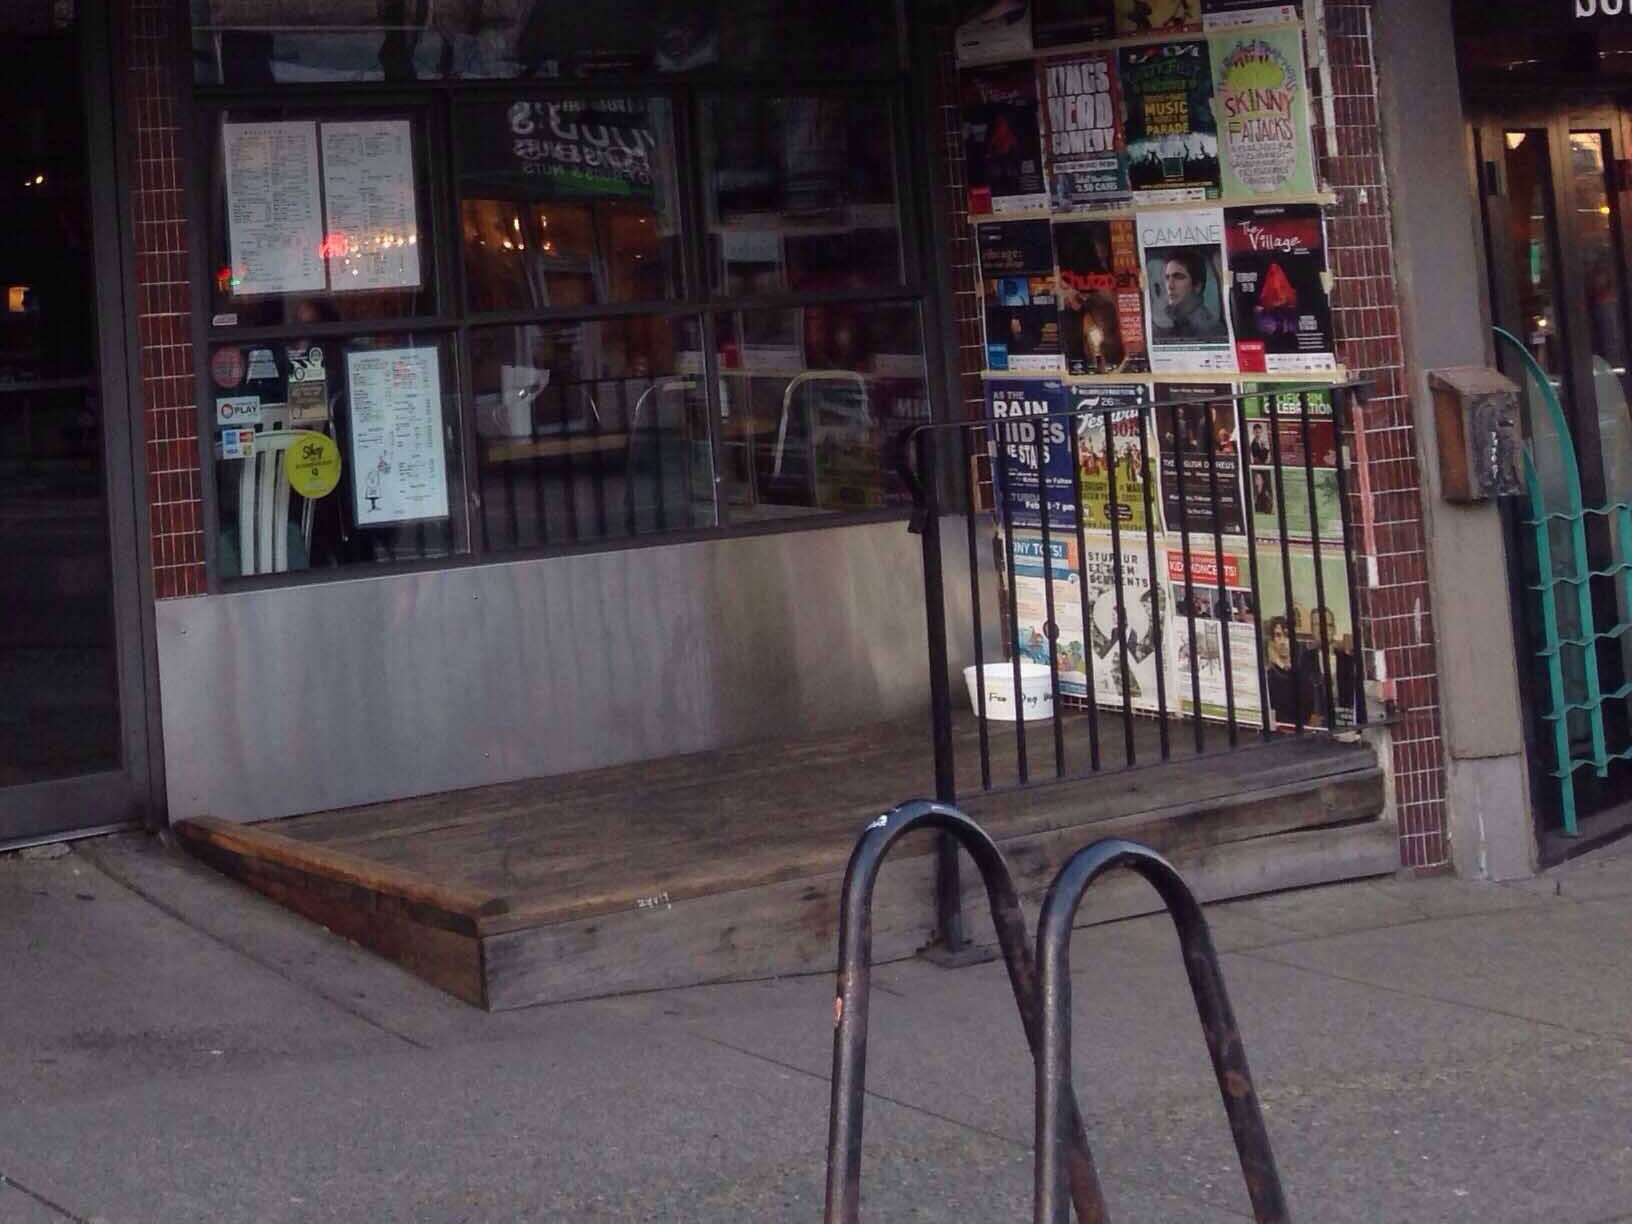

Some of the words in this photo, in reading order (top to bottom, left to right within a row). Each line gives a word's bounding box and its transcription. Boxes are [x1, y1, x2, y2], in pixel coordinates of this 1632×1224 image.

[1144, 100, 1189, 117] MUSIC
[1248, 231, 1302, 253] Village
[993, 400, 1049, 418] RAIN
